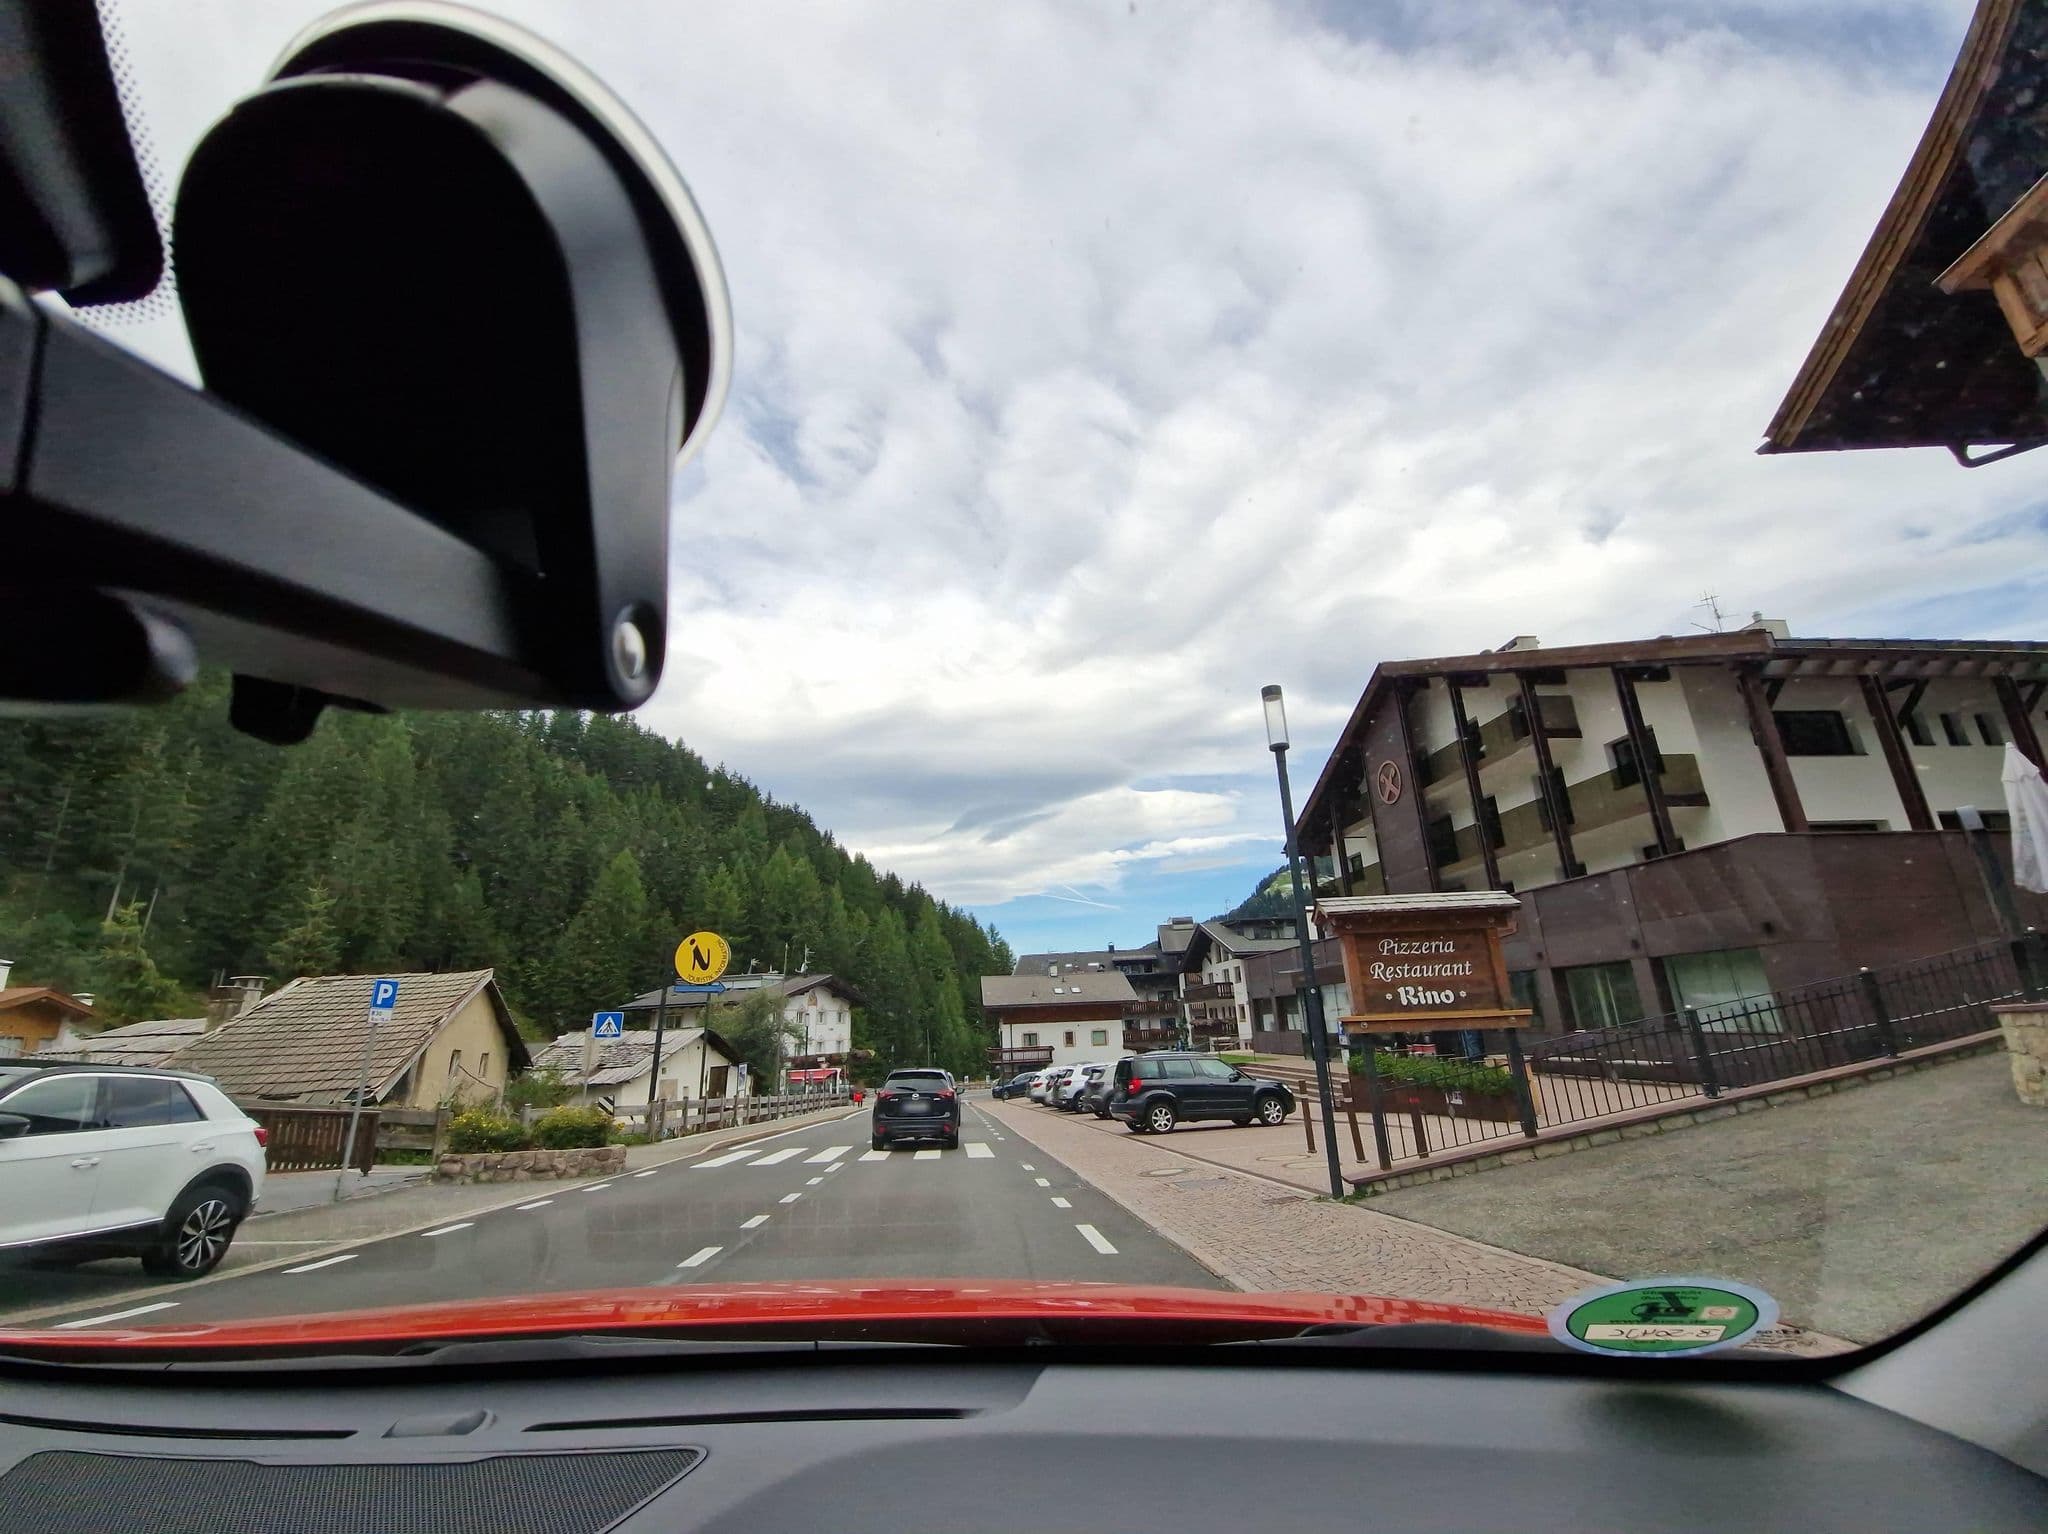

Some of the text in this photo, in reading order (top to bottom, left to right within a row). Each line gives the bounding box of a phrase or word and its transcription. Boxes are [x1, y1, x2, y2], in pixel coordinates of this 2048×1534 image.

[1378, 935, 1456, 956] Pizzeria
[1370, 960, 1473, 982] Restaurant
[376, 983, 394, 1005] P
[1397, 986, 1455, 1006] Rino
